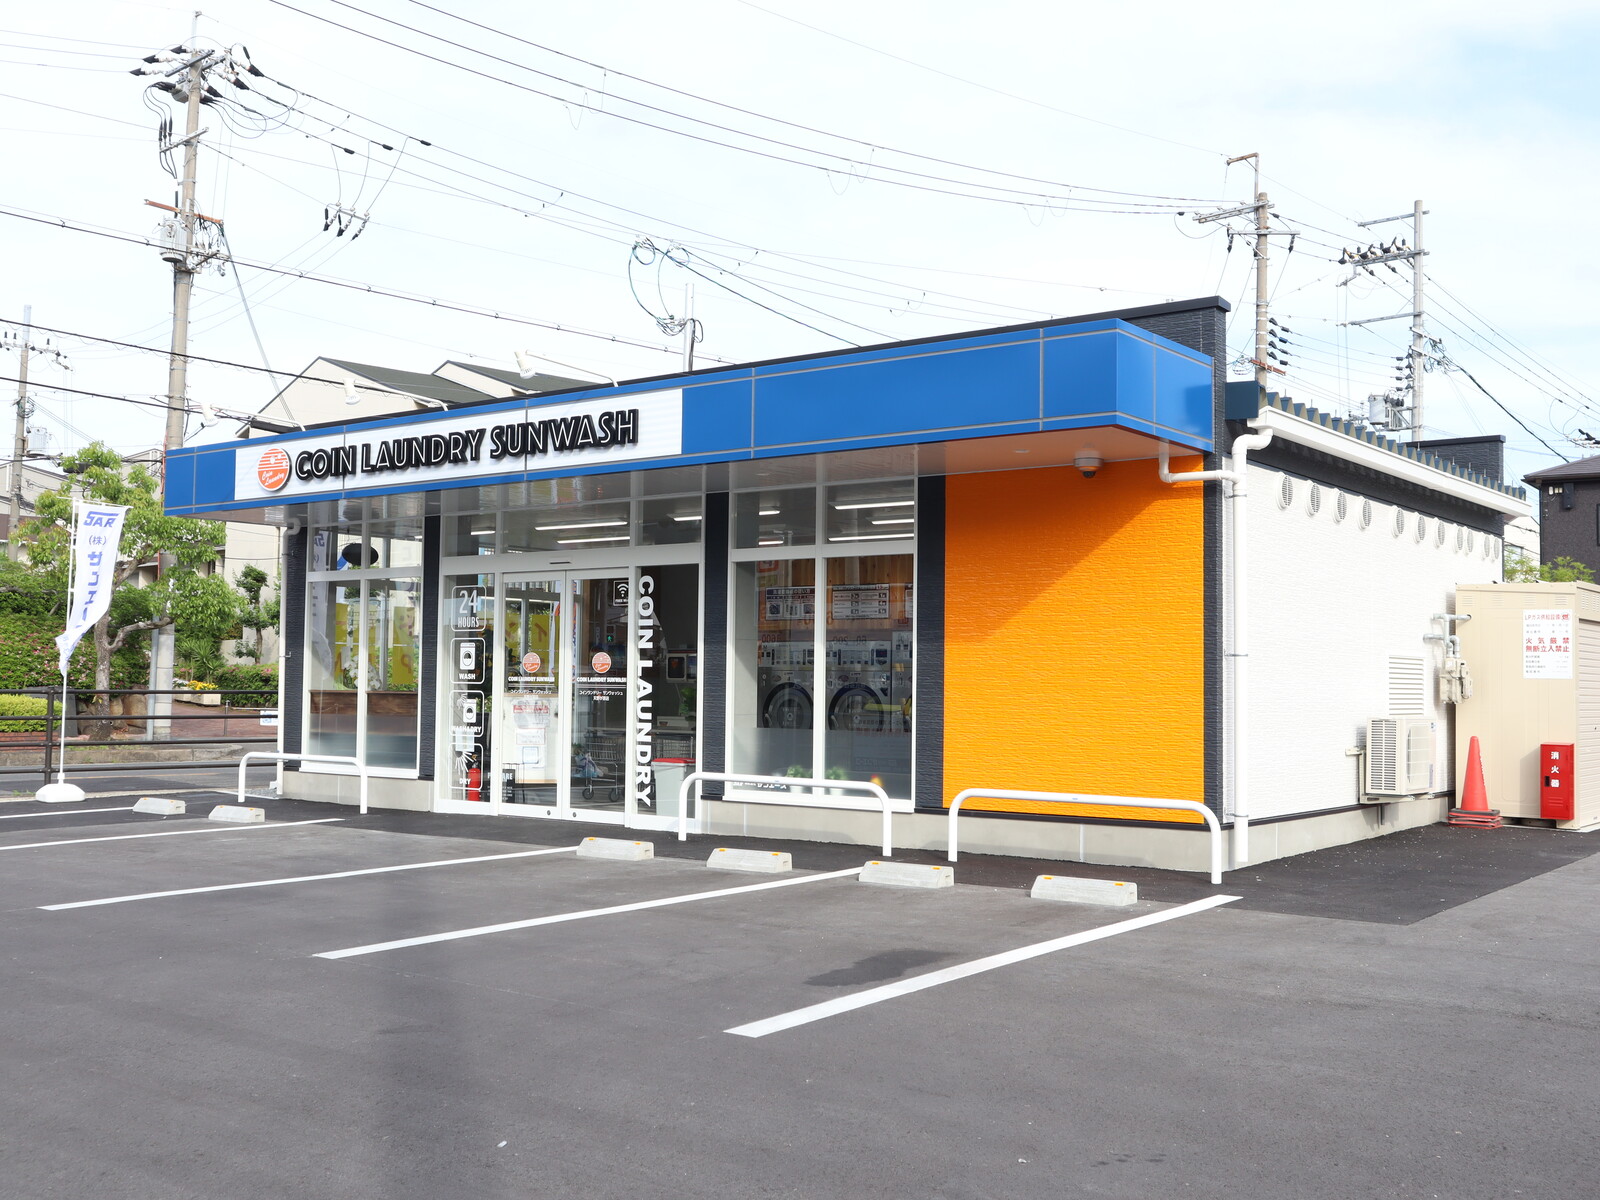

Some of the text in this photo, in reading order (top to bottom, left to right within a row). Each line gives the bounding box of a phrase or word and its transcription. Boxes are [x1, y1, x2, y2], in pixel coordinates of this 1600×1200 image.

[295, 408, 639, 480] COIN LAUNDRY SUNWASH
[83, 511, 120, 528] SAR
[459, 589, 478, 614] 24
[457, 616, 480, 628] HOURS
[636, 575, 655, 807] COIN LAUNDRY
